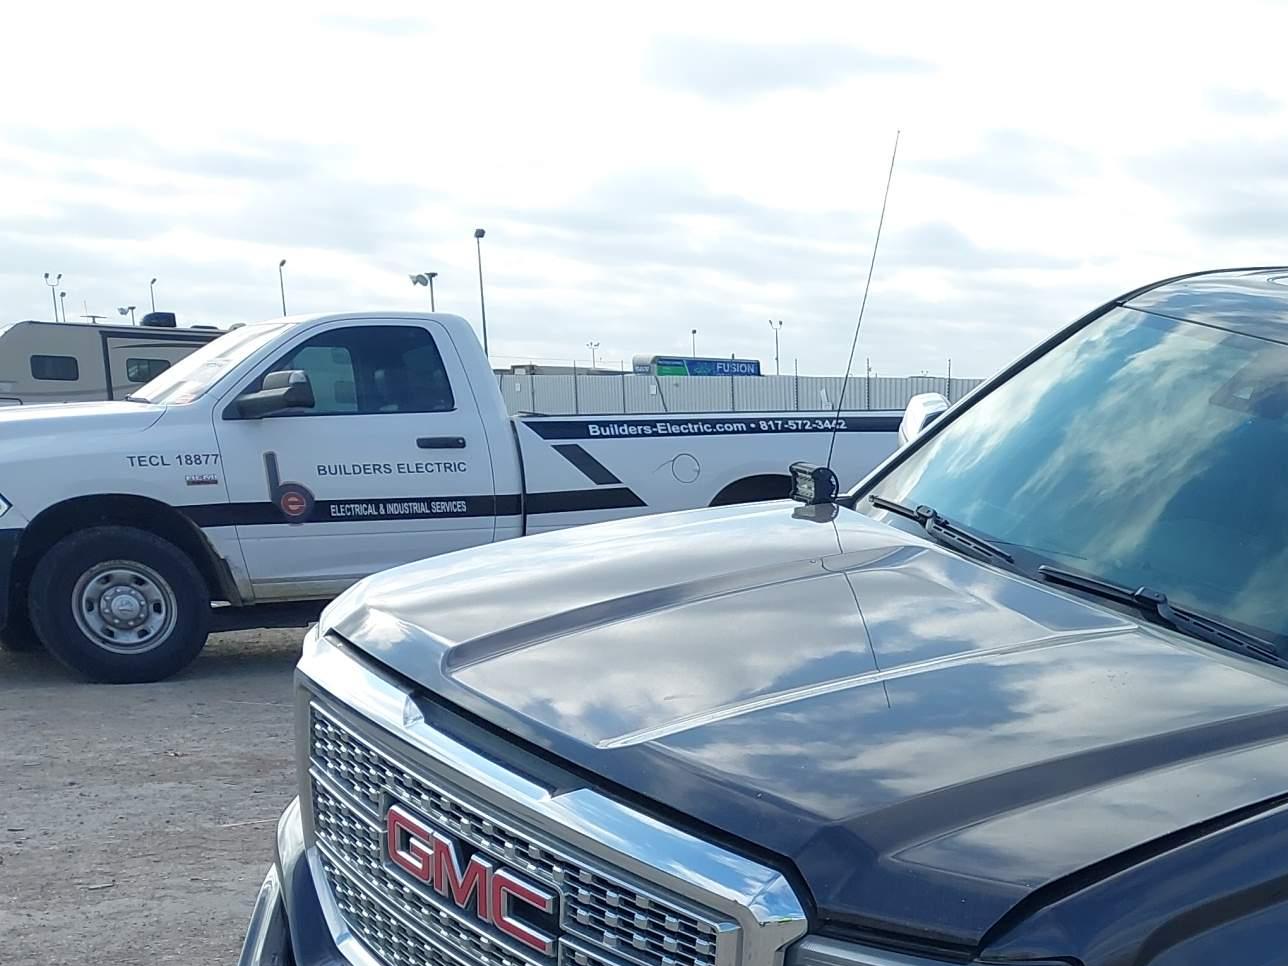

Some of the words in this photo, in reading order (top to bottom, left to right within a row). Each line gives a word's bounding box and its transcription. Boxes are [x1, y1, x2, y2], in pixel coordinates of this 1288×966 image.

[716, 362, 755, 373] FUSION
[588, 422, 746, 436] Builders-Electric.com
[126, 455, 171, 467] TECL
[176, 453, 219, 466] 18877
[317, 463, 392, 476] BUILDERS
[397, 462, 467, 474] ELECTRIC
[330, 504, 377, 516] ELECTRICAL
[387, 502, 430, 514] INDUSTRIAL
[431, 501, 467, 513] SERVICES
[387, 806, 556, 956] GMC
